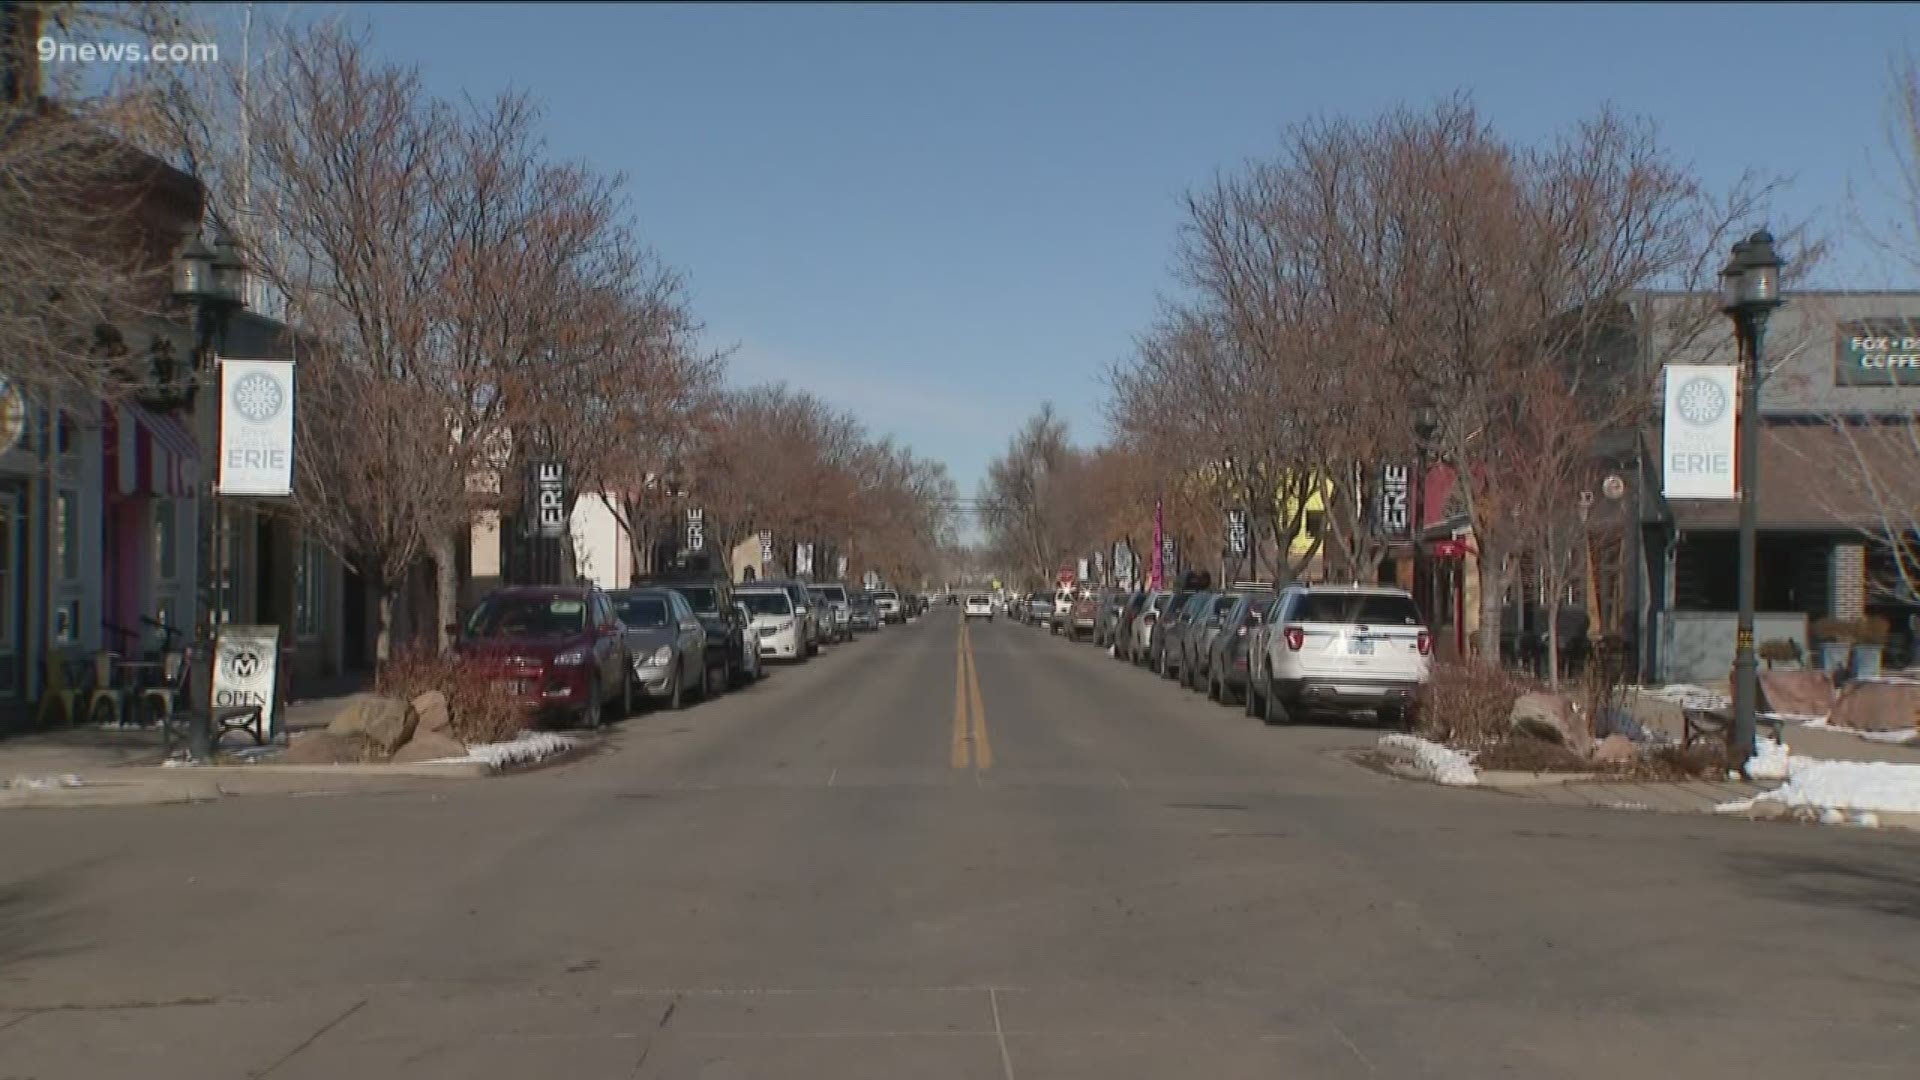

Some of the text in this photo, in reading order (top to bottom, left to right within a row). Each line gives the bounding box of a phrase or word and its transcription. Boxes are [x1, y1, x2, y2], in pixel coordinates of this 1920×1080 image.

[1852, 337, 1889, 351] FOX
[228, 449, 284, 469] ERIE
[1671, 453, 1728, 473] ERIE
[540, 462, 563, 522] ERIE
[1383, 464, 1407, 528] ERIE
[687, 508, 703, 549] ERIE
[760, 529, 771, 561] ERIE
[217, 691, 267, 706] OPEN
